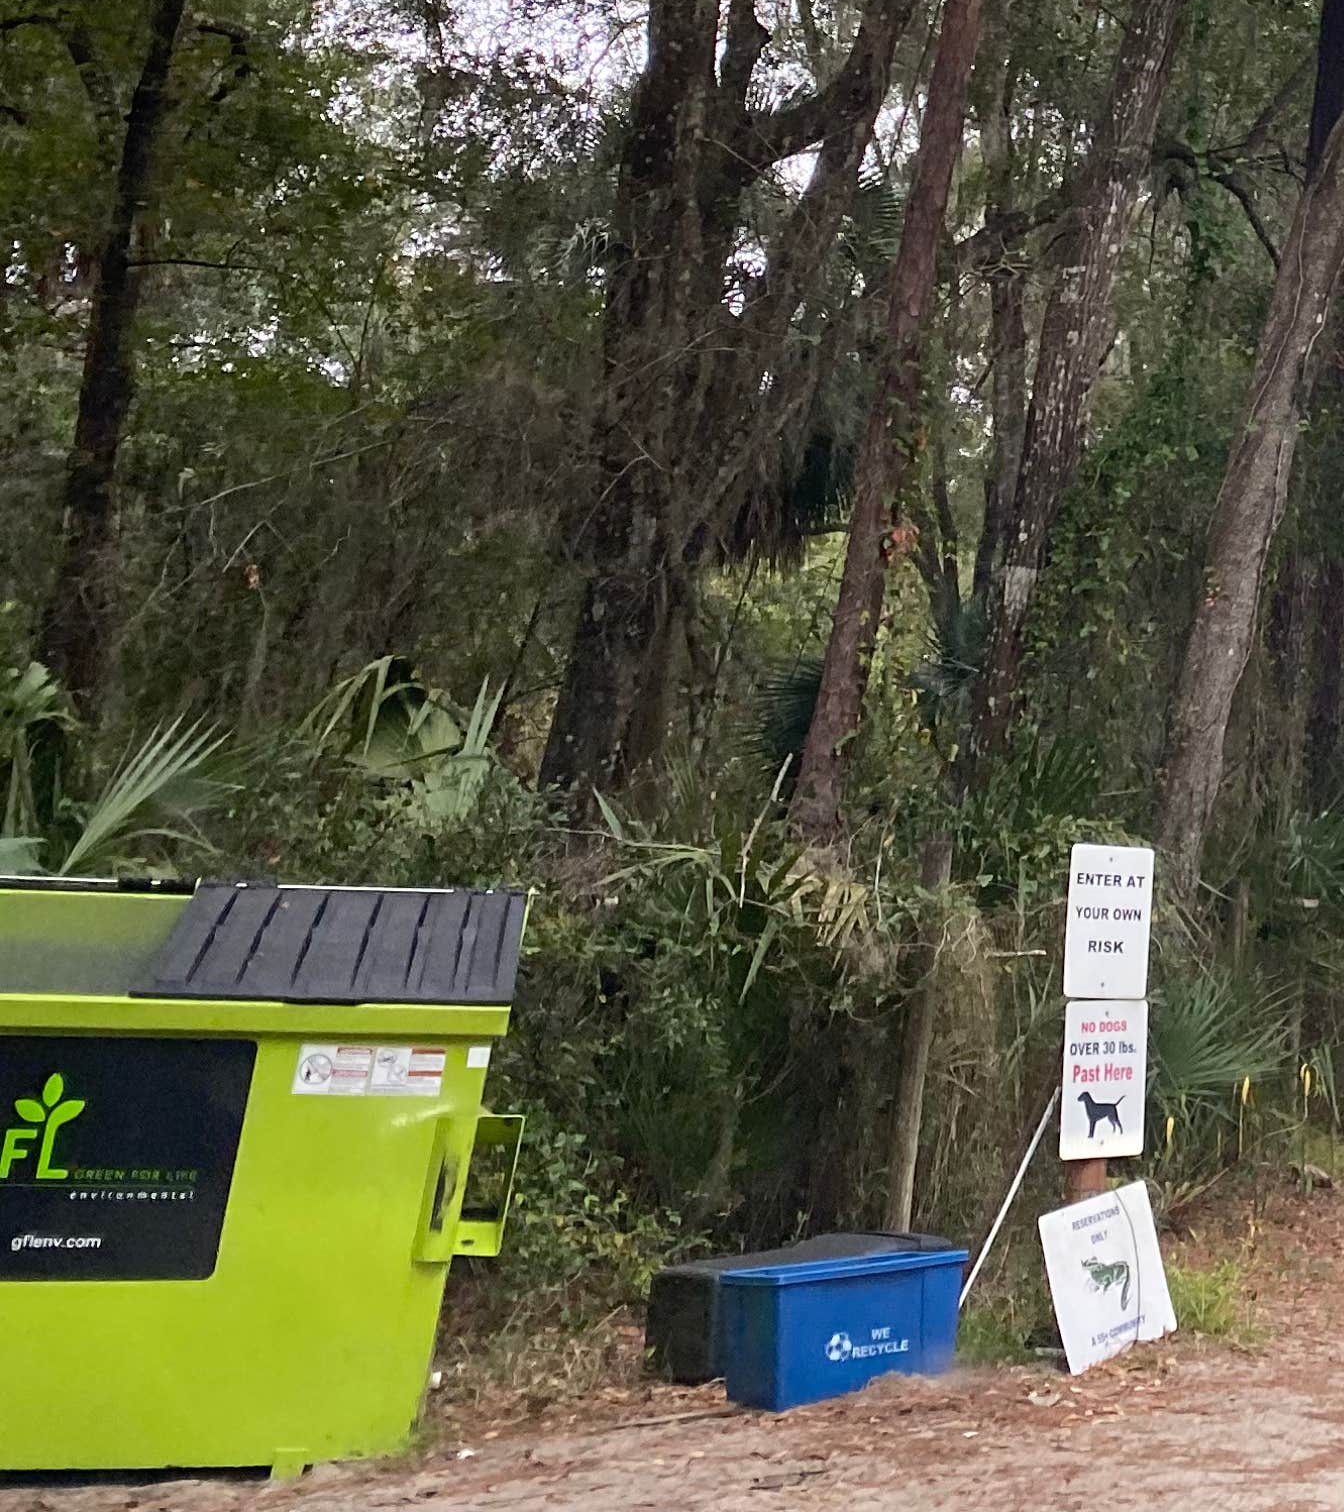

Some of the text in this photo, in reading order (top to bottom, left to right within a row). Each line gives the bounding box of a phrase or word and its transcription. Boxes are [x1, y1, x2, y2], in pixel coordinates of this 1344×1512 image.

[1076, 872, 1145, 888] ENTER AT
[1075, 906, 1142, 921] YOUR OWN
[1087, 940, 1124, 954] RISK
[1081, 1019, 1127, 1034] NO DOGS
[1070, 1040, 1137, 1056] OVER 30 lbs.
[1073, 1063, 1133, 1083] Past Here
[11, 1234, 102, 1252] gflenv.com
[871, 1327, 890, 1340] WE
[852, 1339, 909, 1360] RECYCLE
